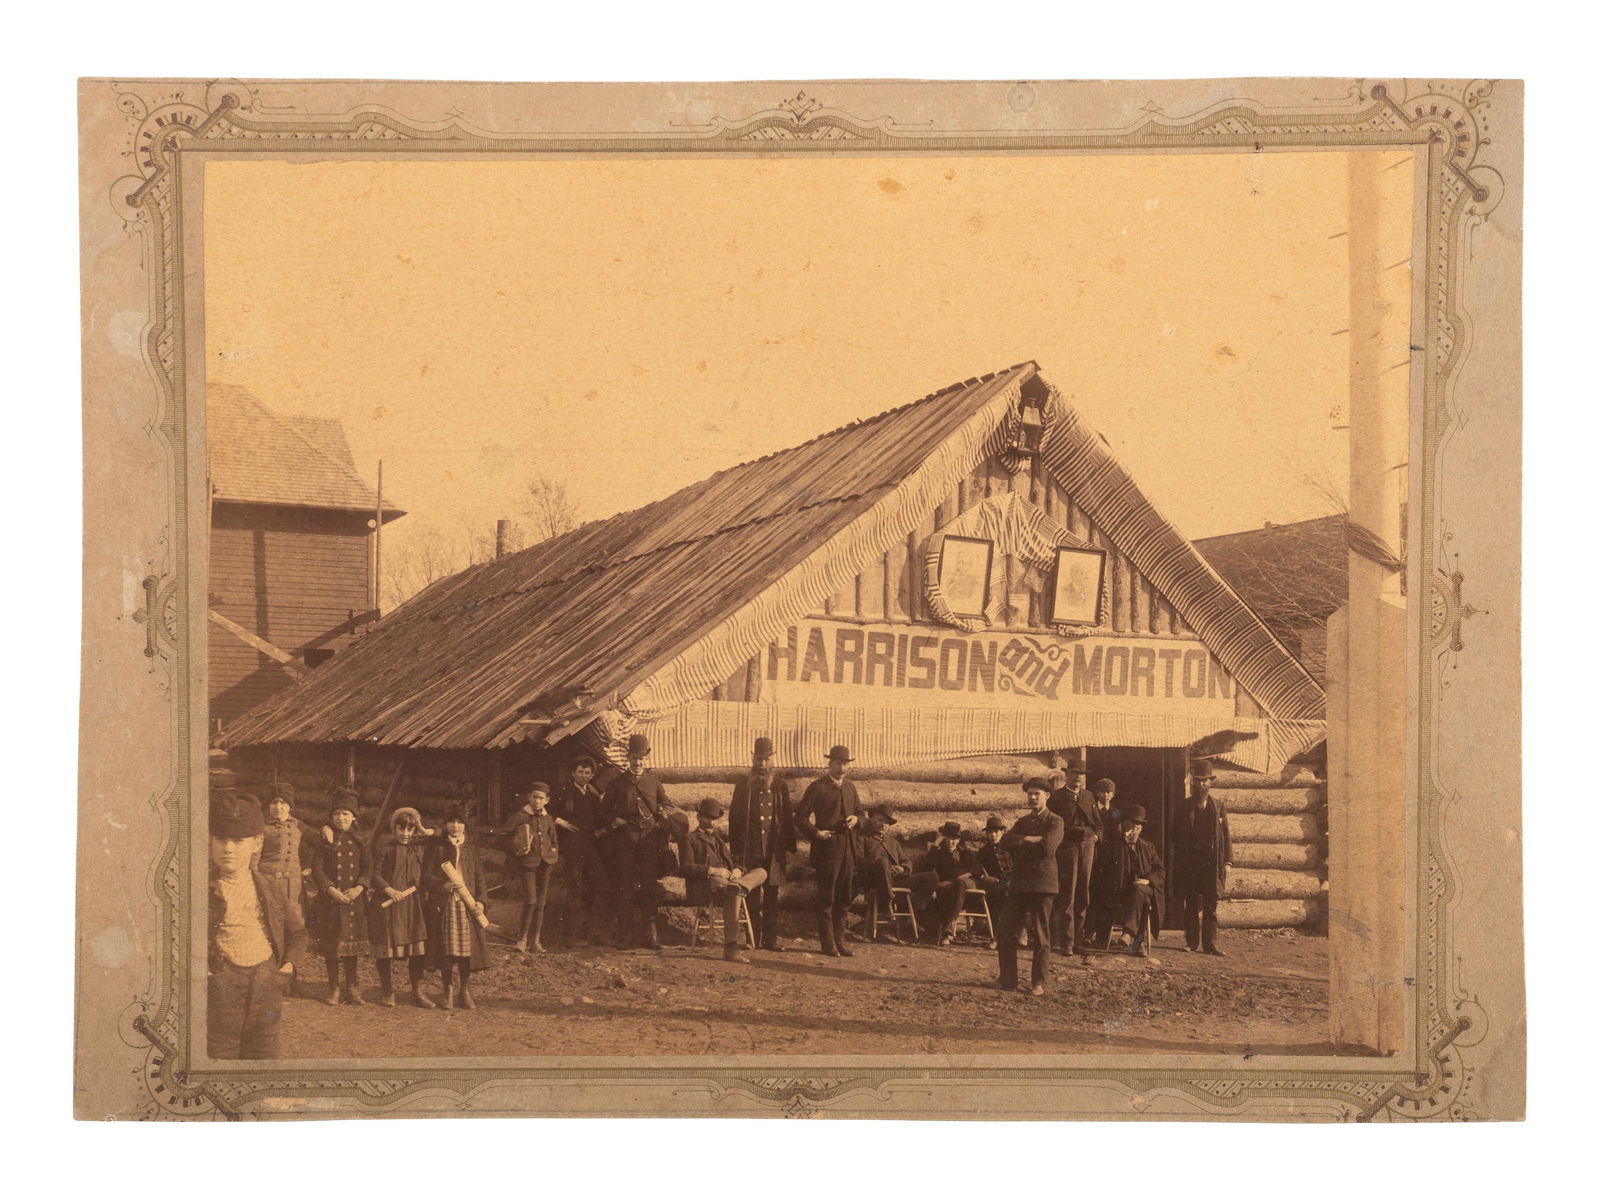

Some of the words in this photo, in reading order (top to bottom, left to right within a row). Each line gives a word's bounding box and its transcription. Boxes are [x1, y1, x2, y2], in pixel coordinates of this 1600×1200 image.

[767, 626, 998, 692] HARRISON
[1000, 637, 1070, 700] and
[1073, 644, 1236, 698] MORTON
